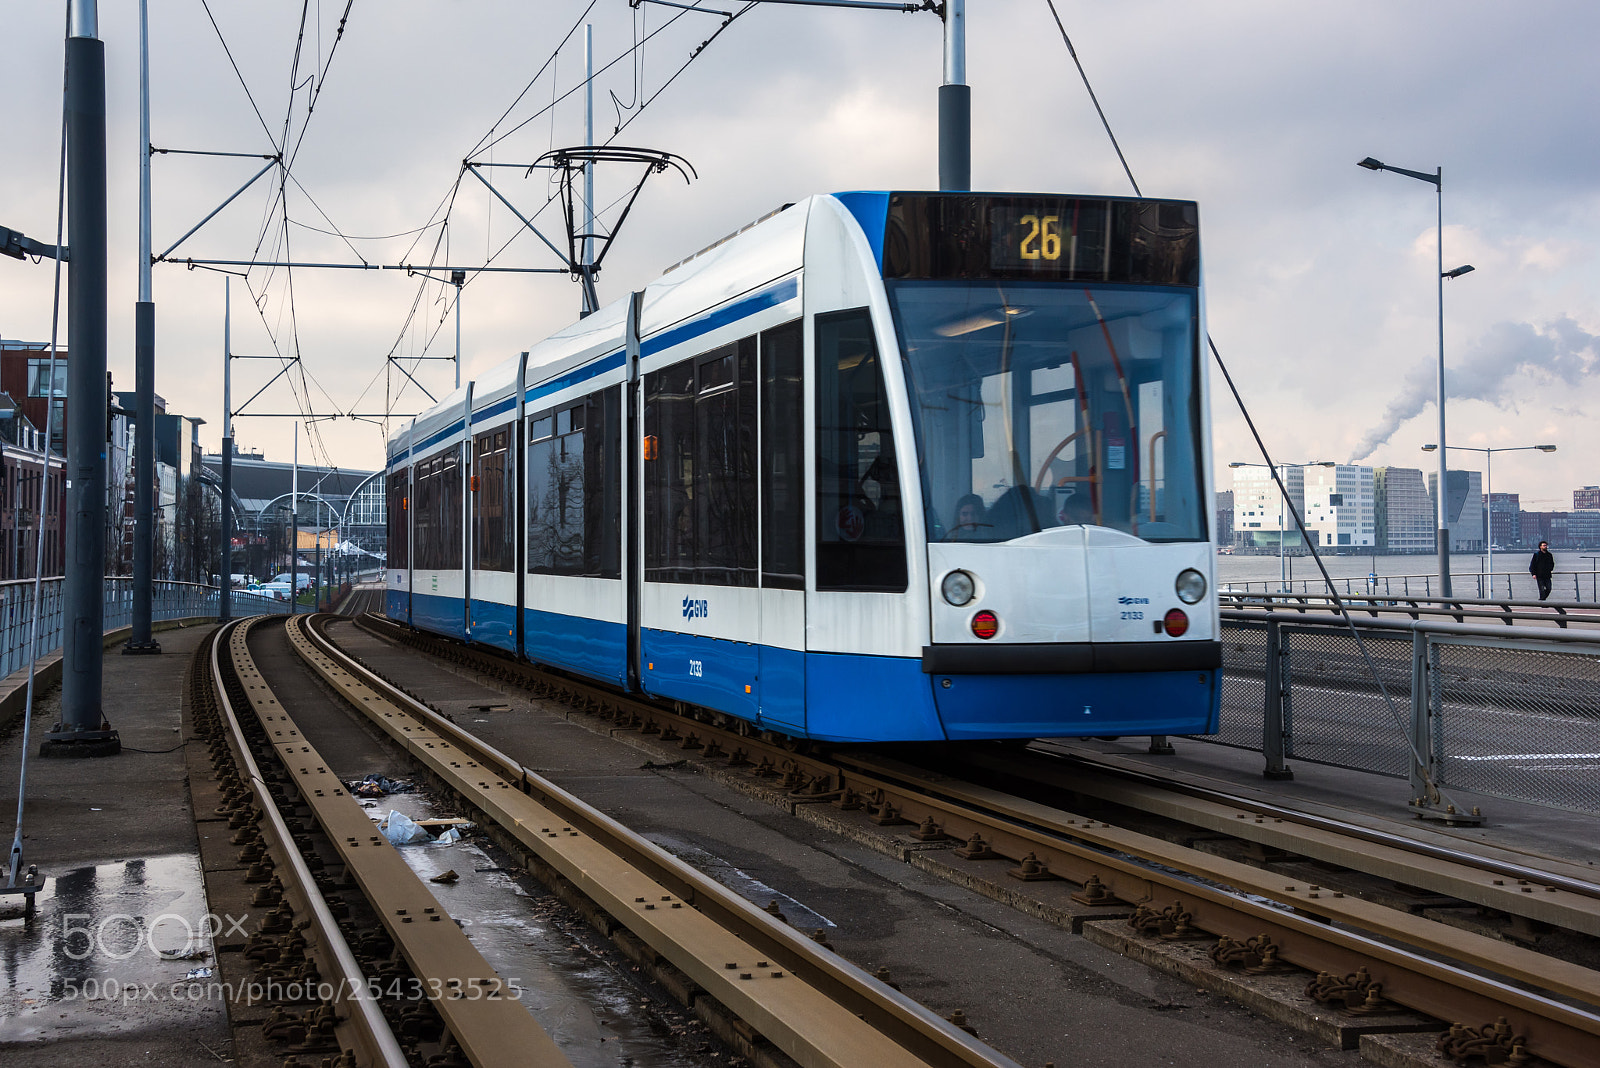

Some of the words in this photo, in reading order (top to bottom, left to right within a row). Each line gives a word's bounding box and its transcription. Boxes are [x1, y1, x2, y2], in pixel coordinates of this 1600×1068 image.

[1019, 214, 1062, 261] 26
[694, 599, 708, 618] GVB
[1120, 611, 1144, 620] 2133
[689, 659, 703, 678] 2133
